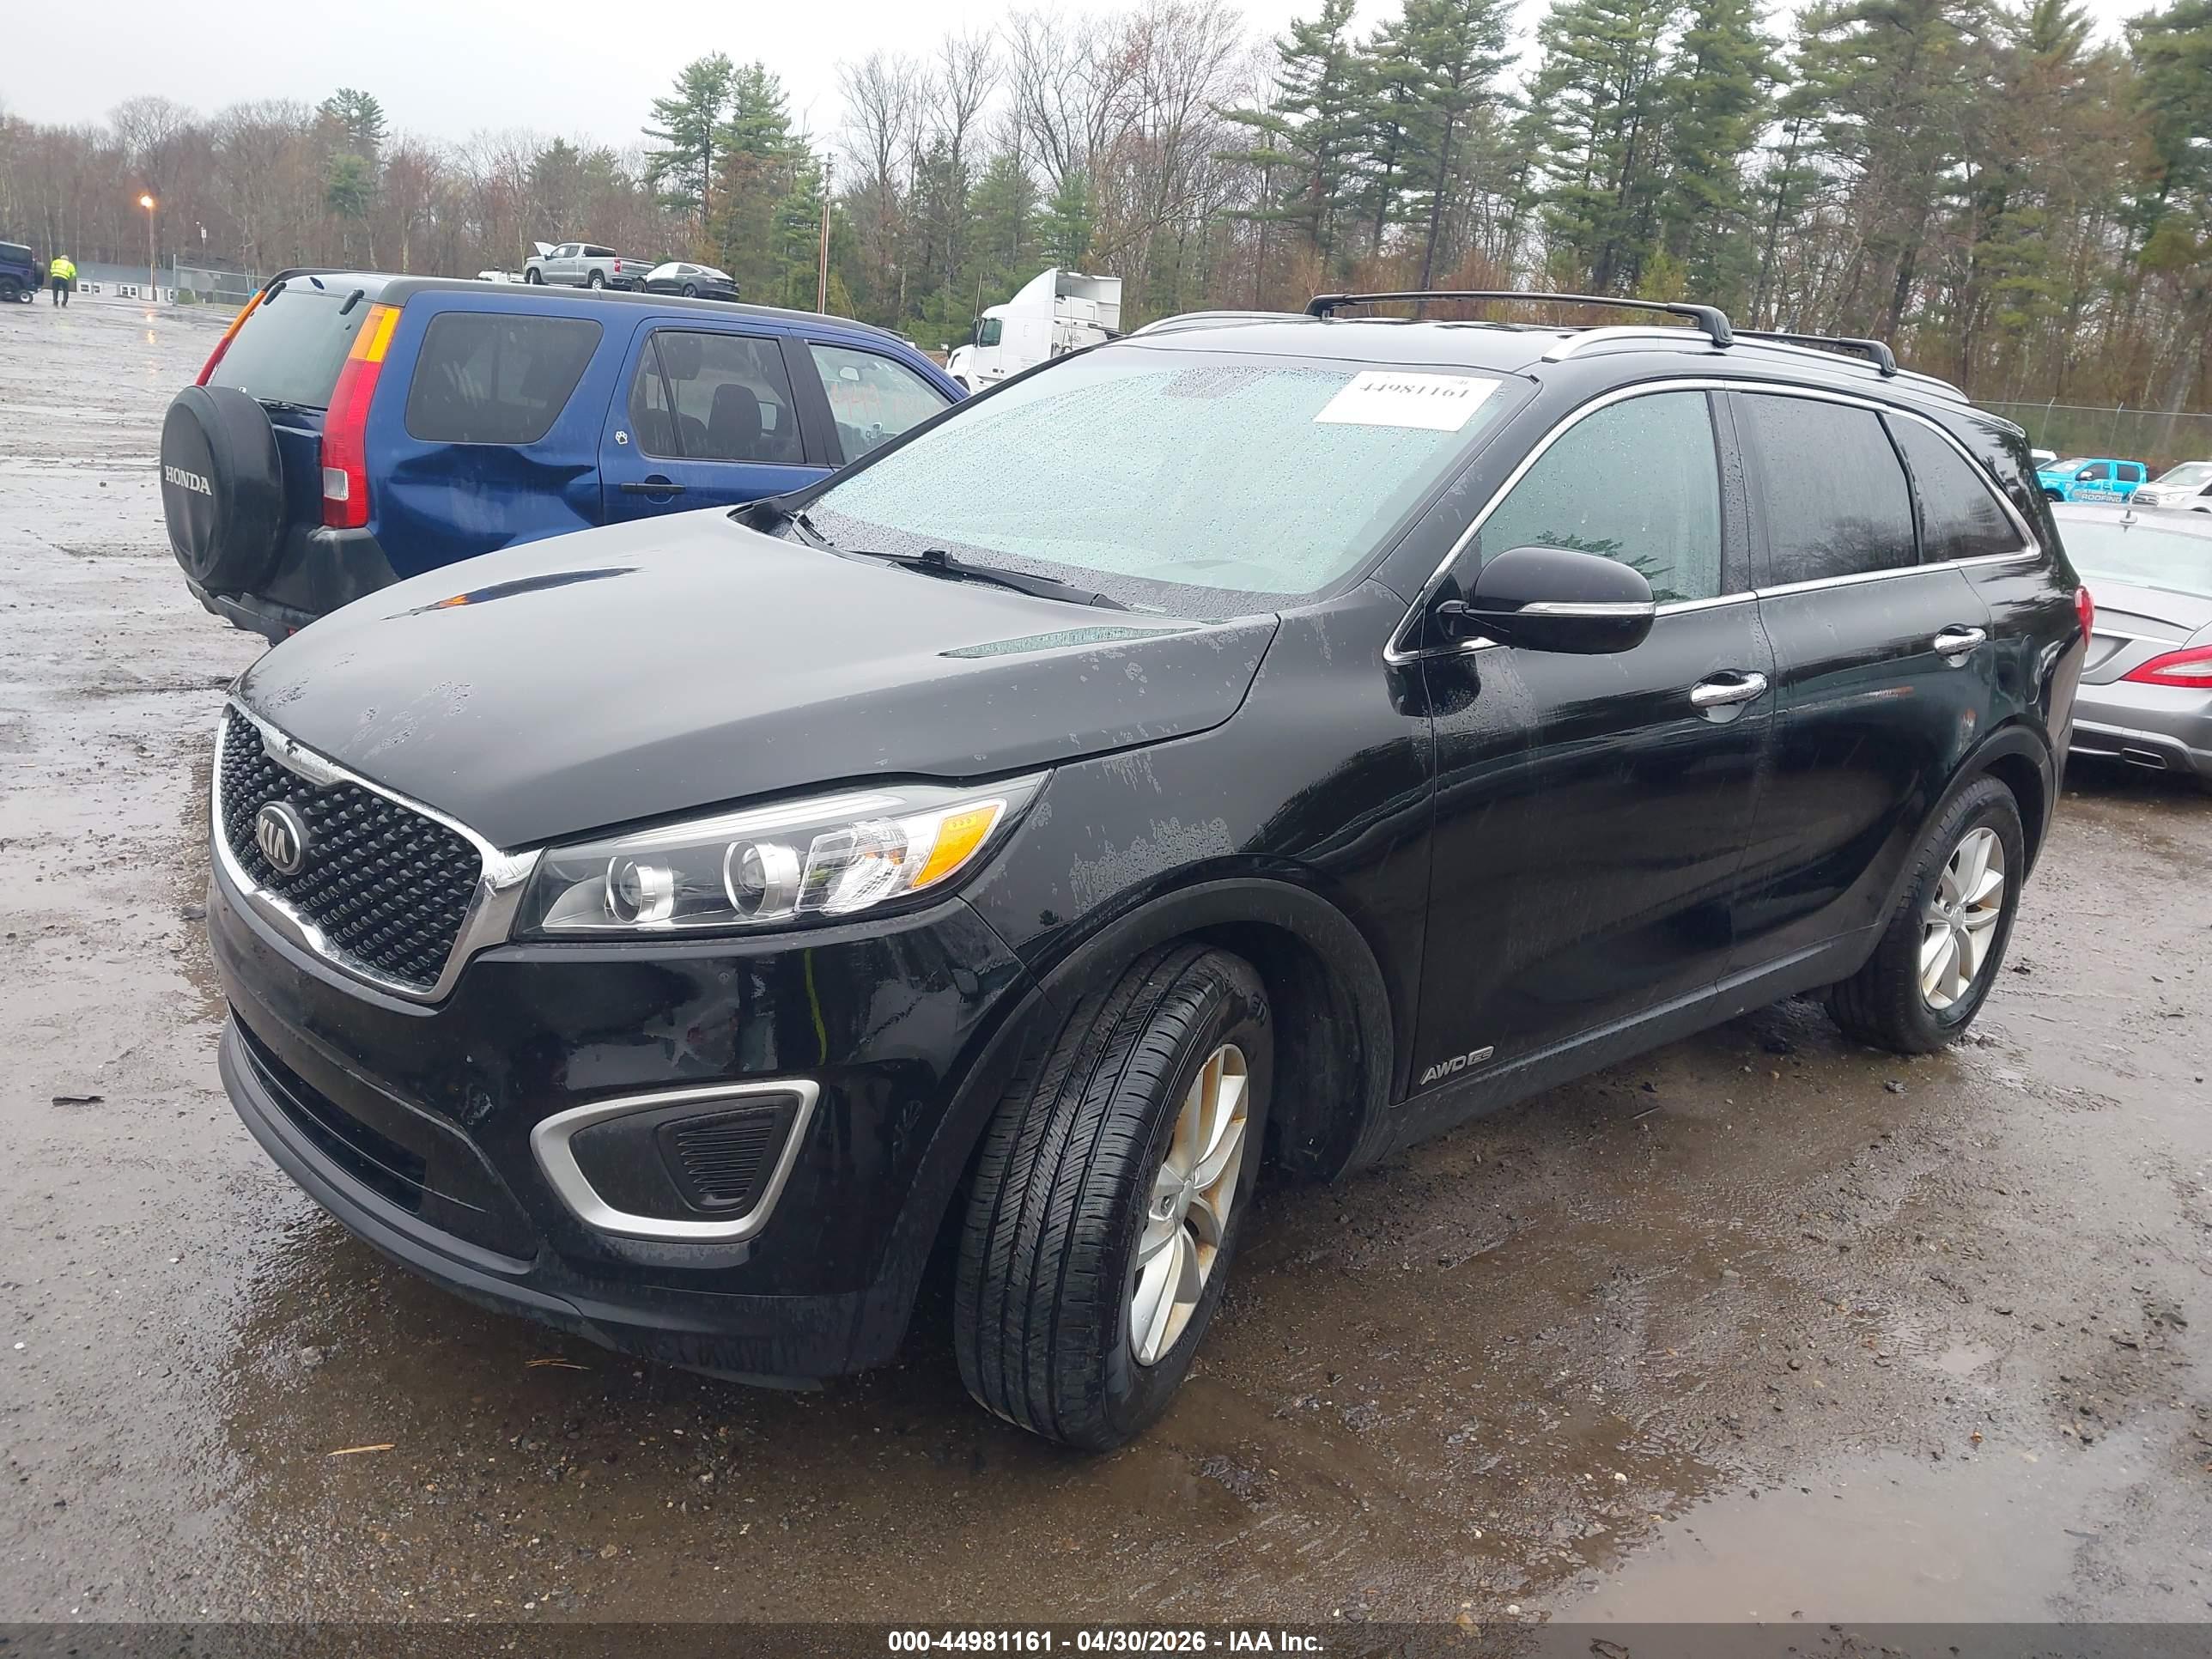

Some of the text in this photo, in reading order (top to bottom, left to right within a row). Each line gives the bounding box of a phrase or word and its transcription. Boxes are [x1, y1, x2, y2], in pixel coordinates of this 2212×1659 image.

[165, 465, 212, 495] HONDA
[2081, 494, 2123, 503] ROOFING
[258, 816, 289, 864] KIA
[1419, 1055, 1467, 1085] AWD
